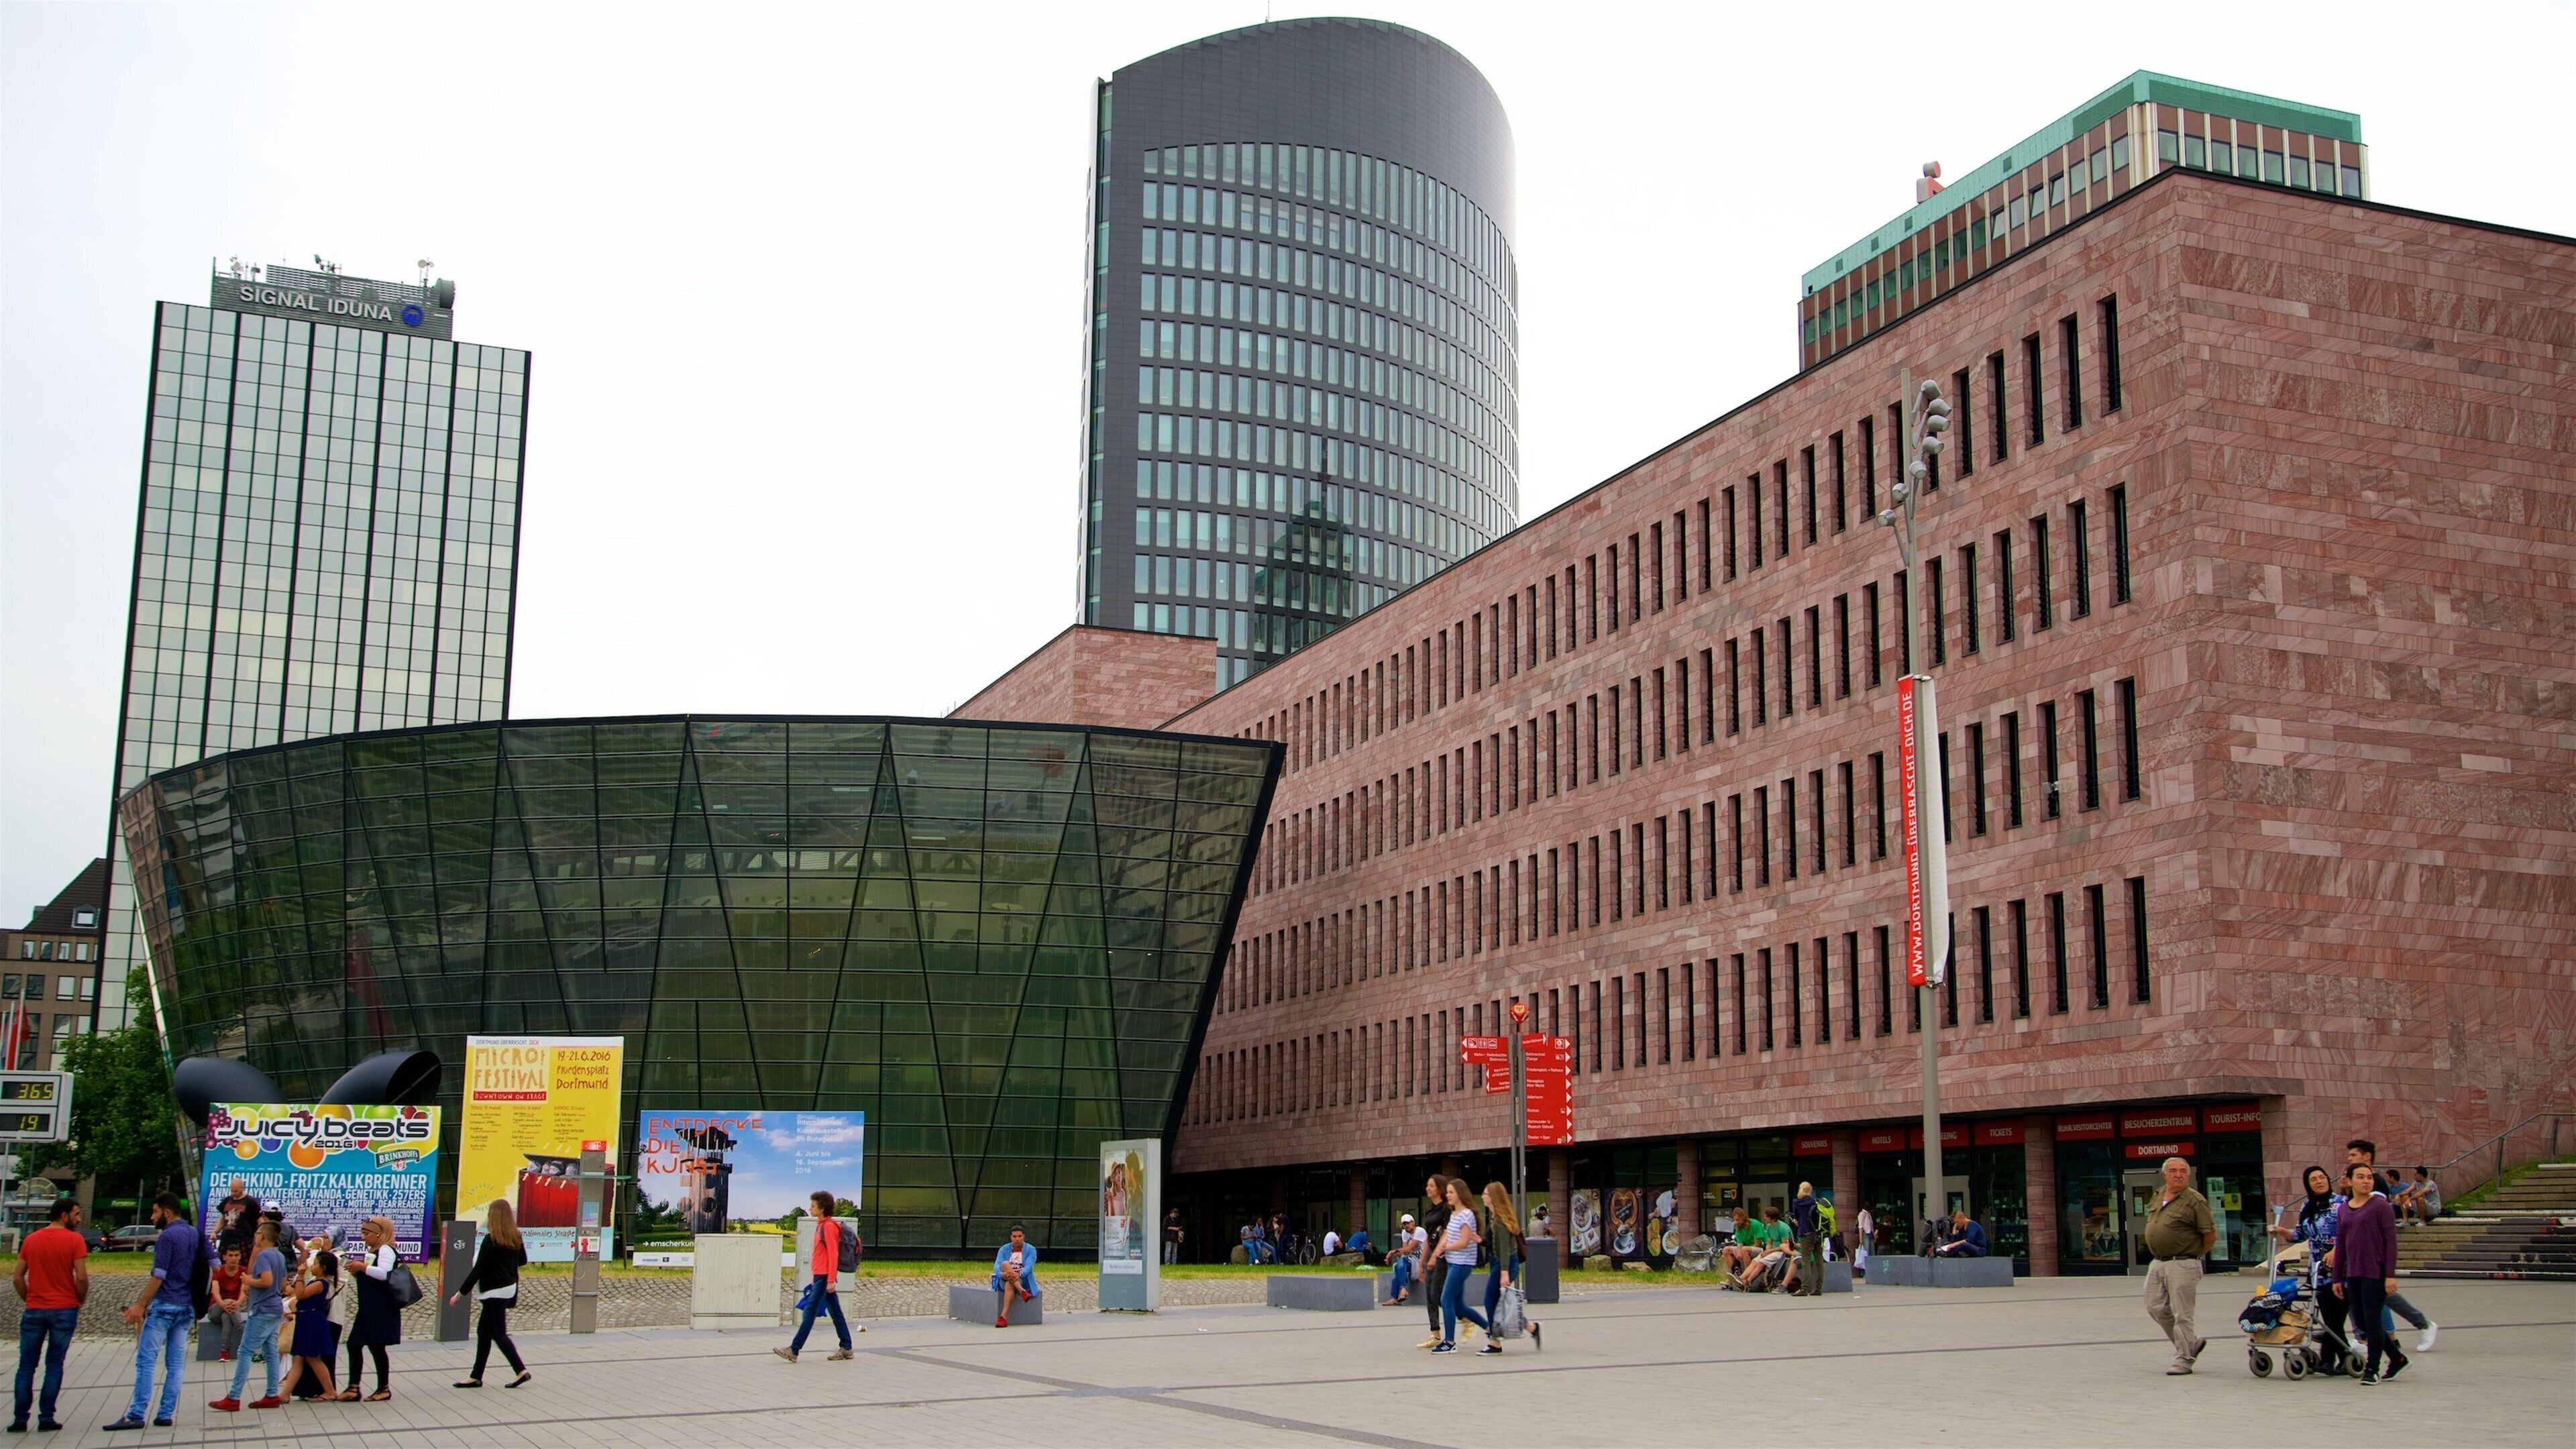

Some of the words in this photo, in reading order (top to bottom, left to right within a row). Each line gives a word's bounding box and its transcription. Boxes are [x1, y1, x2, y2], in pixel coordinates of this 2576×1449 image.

[240, 286, 321, 311] SIGNAL
[327, 299, 392, 322] IDUNA
[1902, 691, 1923, 977] WWW.DORTMUND-ÜBERRASCHT-DICH.DE
[17, 1083, 53, 1099] 365
[474, 1092, 513, 1100] DOWNTOWN
[527, 1092, 545, 1100] STAGE
[20, 1115, 39, 1130] 19
[2124, 1116, 2192, 1129] BESUCHERZENTRUM
[2210, 1112, 2261, 1124] TOURIST-INFO
[649, 1117, 763, 1136] ENTDECKE
[1989, 1128, 2012, 1137] TICKETS
[647, 1138, 681, 1154] DIE
[1801, 1140, 1828, 1149] SOUVENIRS
[1872, 1136, 1892, 1144] HOTELS
[2138, 1145, 2178, 1155] DORTMUND
[807, 1159, 844, 1167] September
[290, 1173, 327, 1189] FRITZ
[329, 1174, 427, 1189] KALKBRENNER
[310, 1189, 342, 1199] WANDA
[345, 1189, 390, 1199] GENETIKK
[392, 1190, 426, 1200] 257ERS
